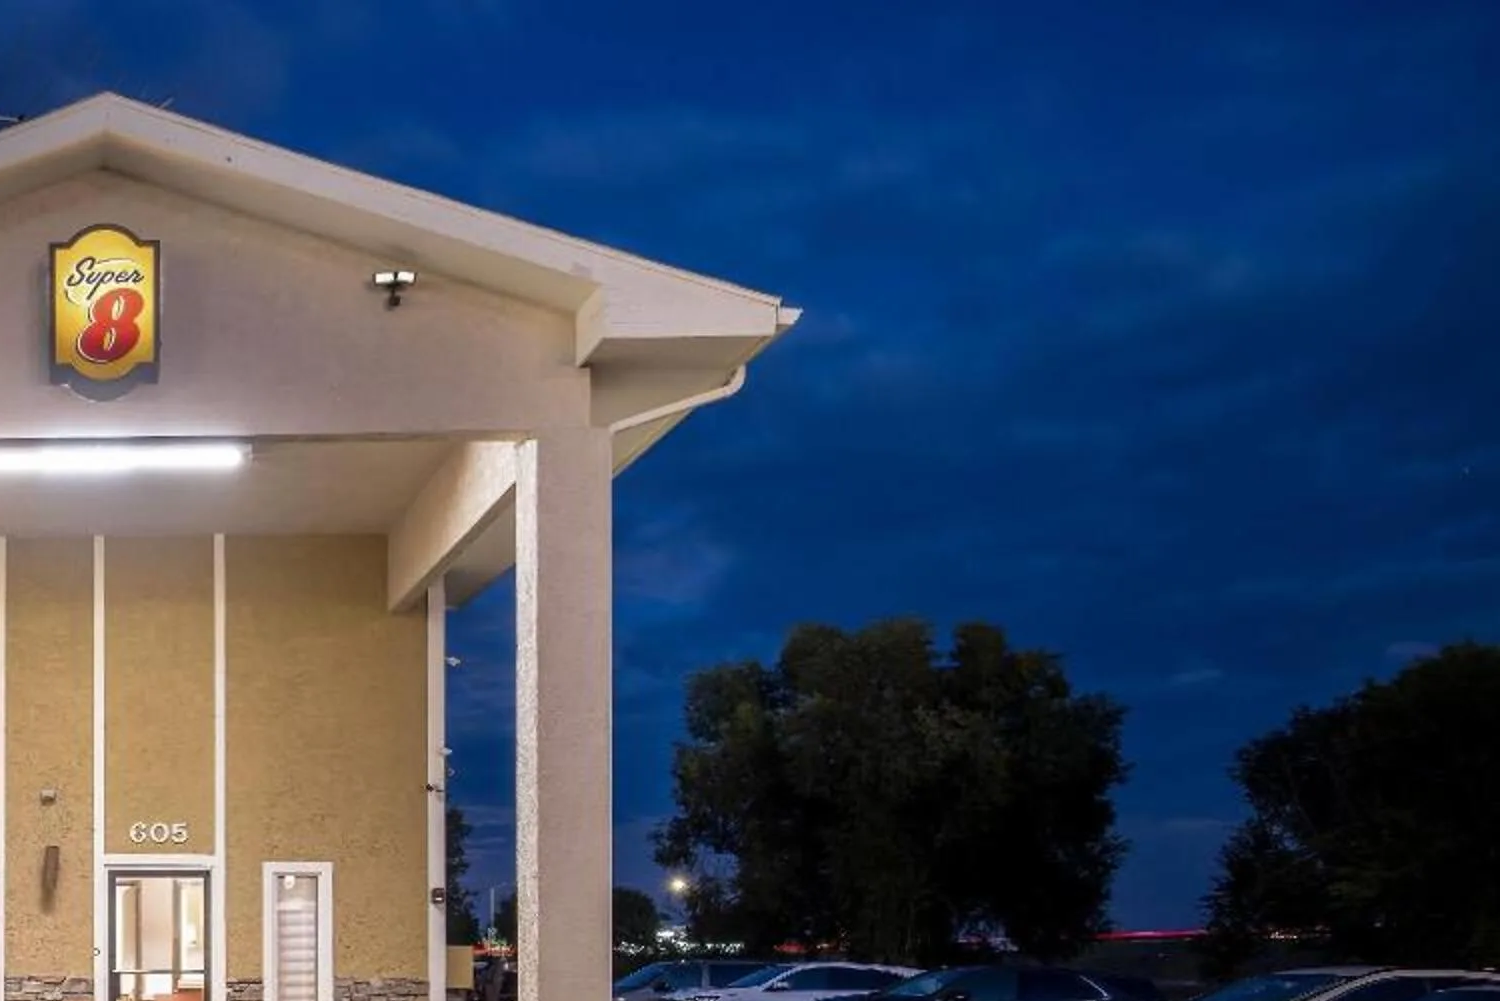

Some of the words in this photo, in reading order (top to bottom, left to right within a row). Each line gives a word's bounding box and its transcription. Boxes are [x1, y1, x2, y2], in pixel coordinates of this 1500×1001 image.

[67, 256, 144, 300] Super
[76, 287, 144, 363] 8
[130, 821, 188, 844] 605
